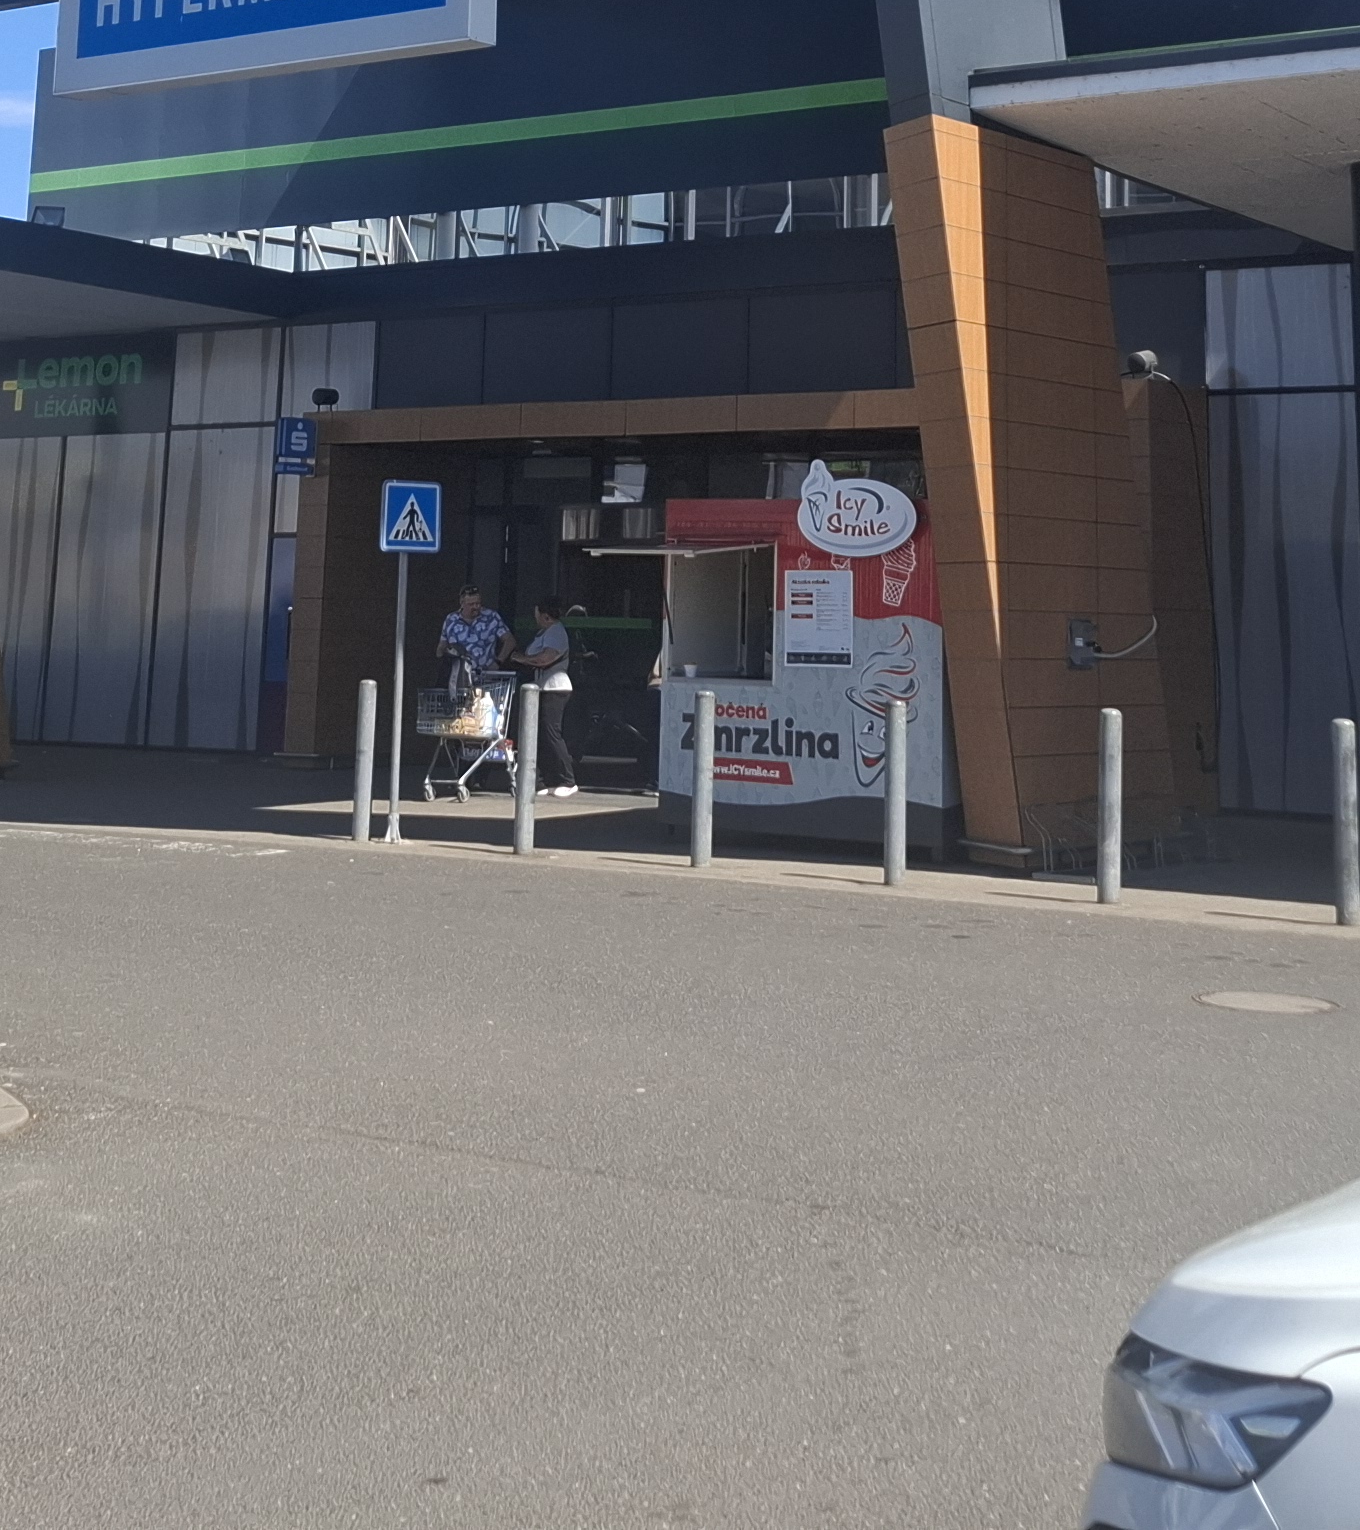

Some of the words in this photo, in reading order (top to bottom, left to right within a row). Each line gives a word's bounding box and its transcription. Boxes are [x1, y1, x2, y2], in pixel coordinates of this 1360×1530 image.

[17, 353, 143, 390] Lemon
[33, 393, 118, 419] LÉKÁRNA
[835, 489, 867, 521] Icy
[826, 512, 891, 537] Smile
[713, 701, 768, 720] očená
